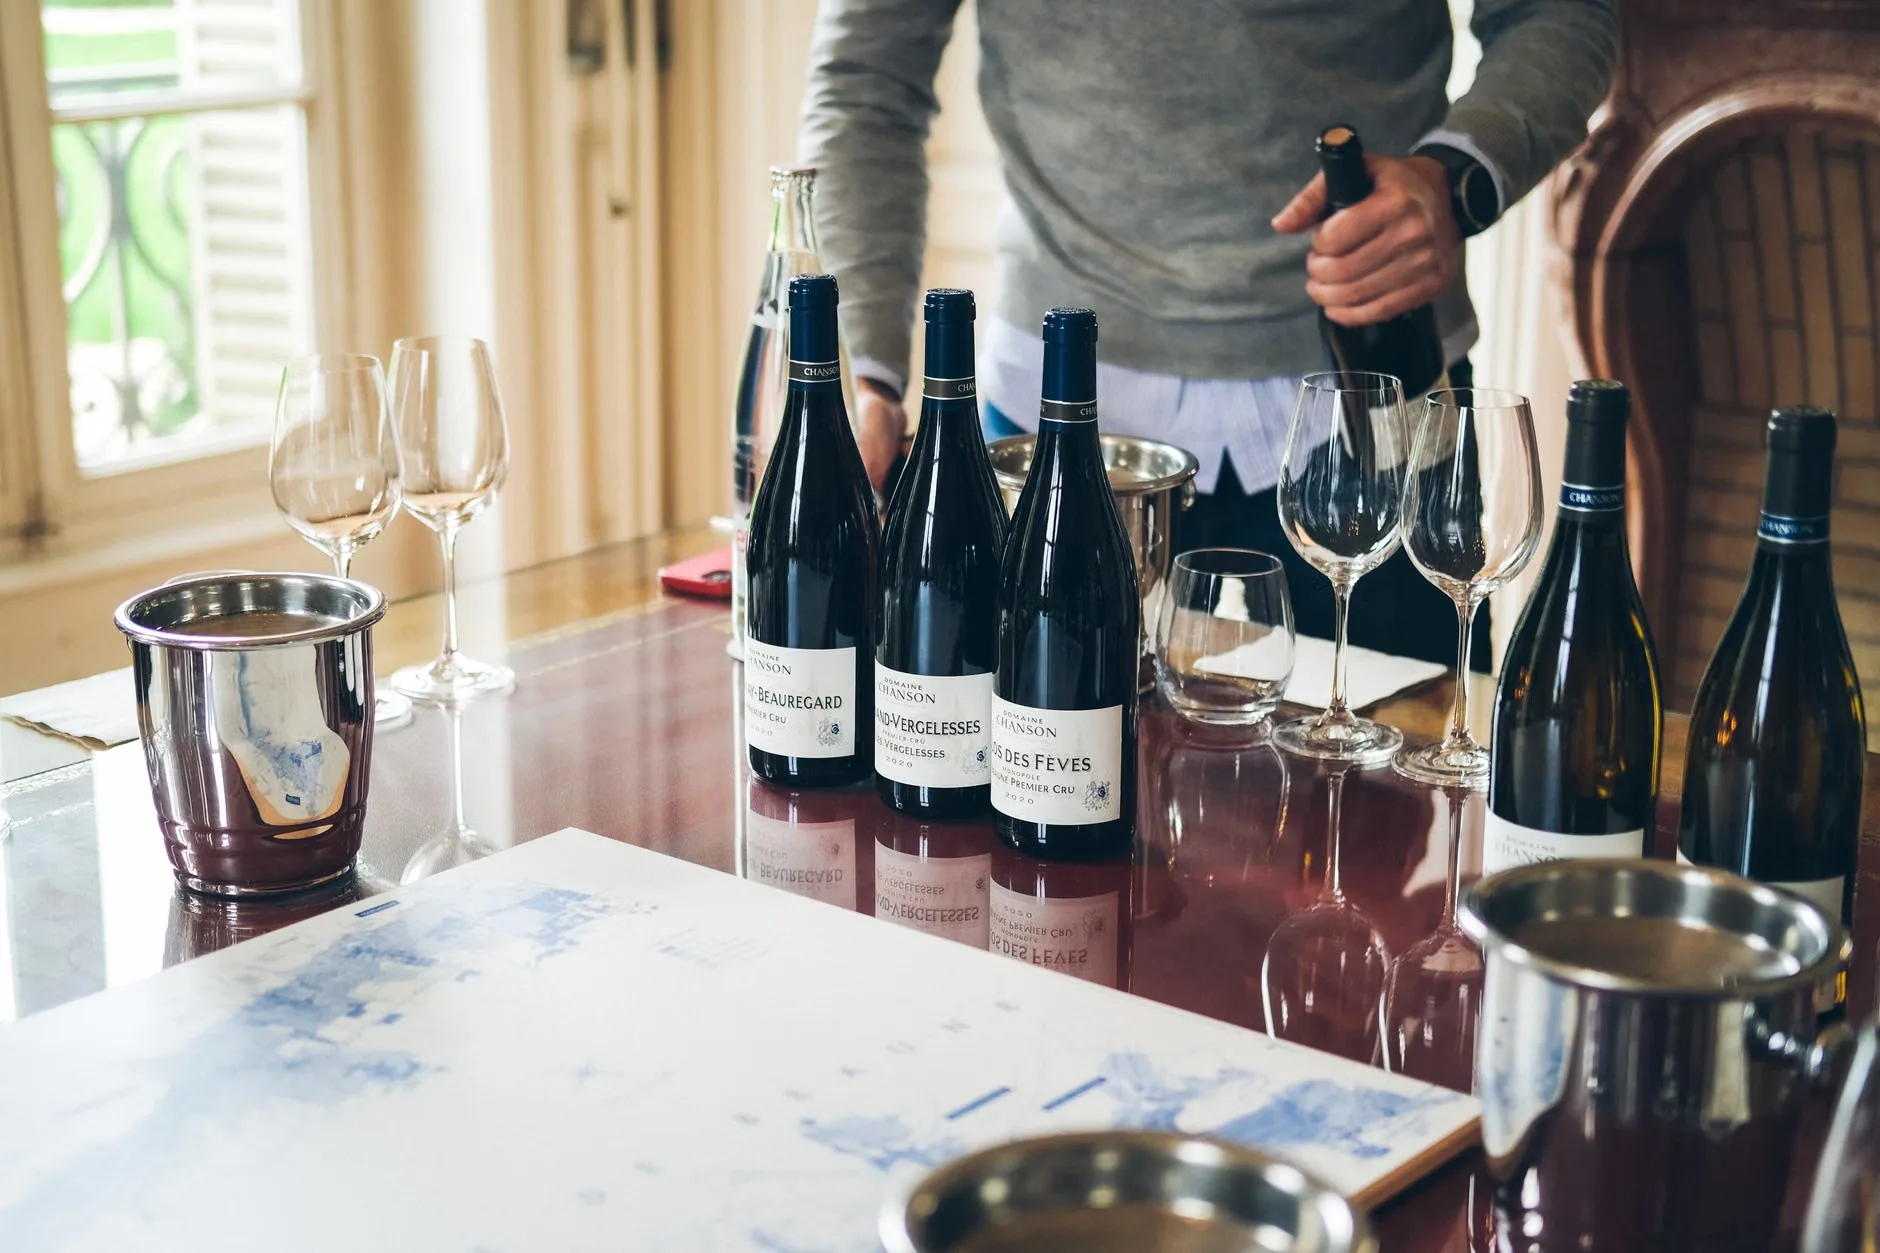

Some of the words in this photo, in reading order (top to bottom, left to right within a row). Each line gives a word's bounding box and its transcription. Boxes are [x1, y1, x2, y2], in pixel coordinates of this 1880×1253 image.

[748, 658, 792, 675] HANSON
[884, 677, 923, 690] DOMAINE
[879, 682, 936, 704] CHANSON
[769, 713, 786, 724] CRU
[1003, 710, 1043, 724] DOMAINE
[997, 715, 1057, 738] CHANSON
[884, 741, 945, 759] VERGELESSES
[886, 756, 912, 768] 2020
[1005, 748, 1029, 768] DES
[1035, 754, 1091, 772] FÈVES
[1002, 767, 1040, 781] MONOPOLE
[1010, 778, 1049, 793] PREMIER
[1053, 785, 1075, 794] CRU
[1005, 792, 1034, 805] 2020
